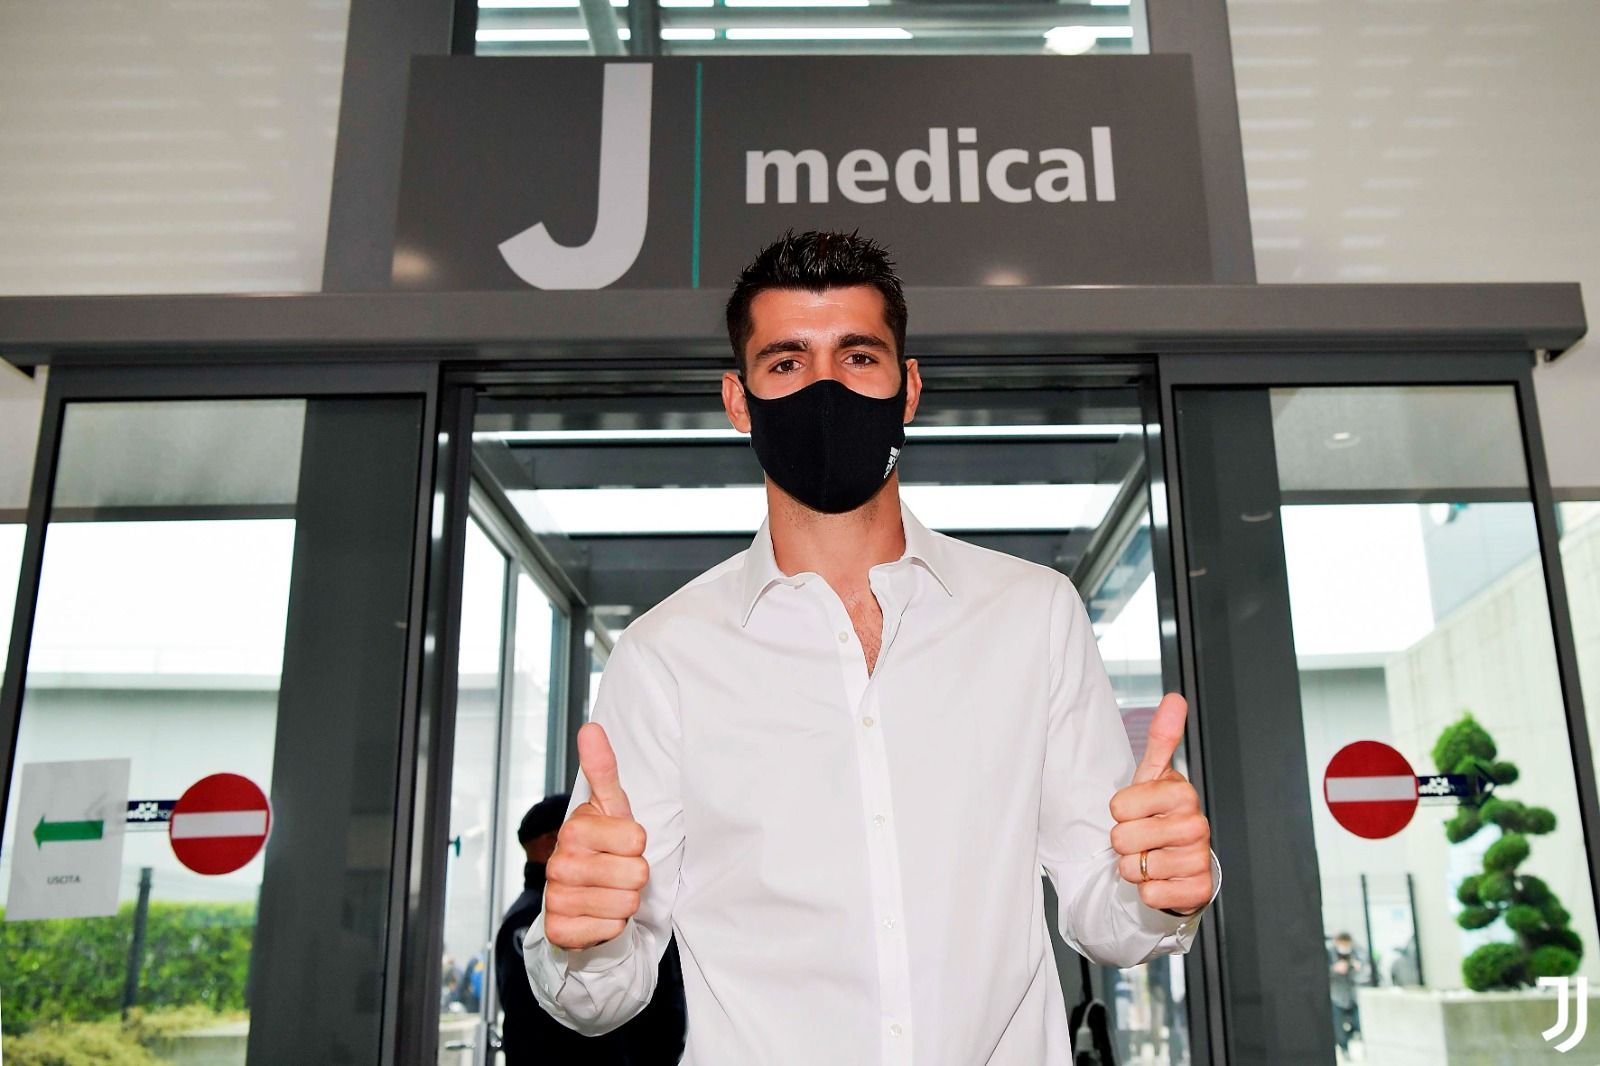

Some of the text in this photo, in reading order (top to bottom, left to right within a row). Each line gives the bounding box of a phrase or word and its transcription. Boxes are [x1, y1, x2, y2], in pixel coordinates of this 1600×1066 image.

[498, 63, 1117, 290] J medical
[47, 875, 81, 885] USCITA
